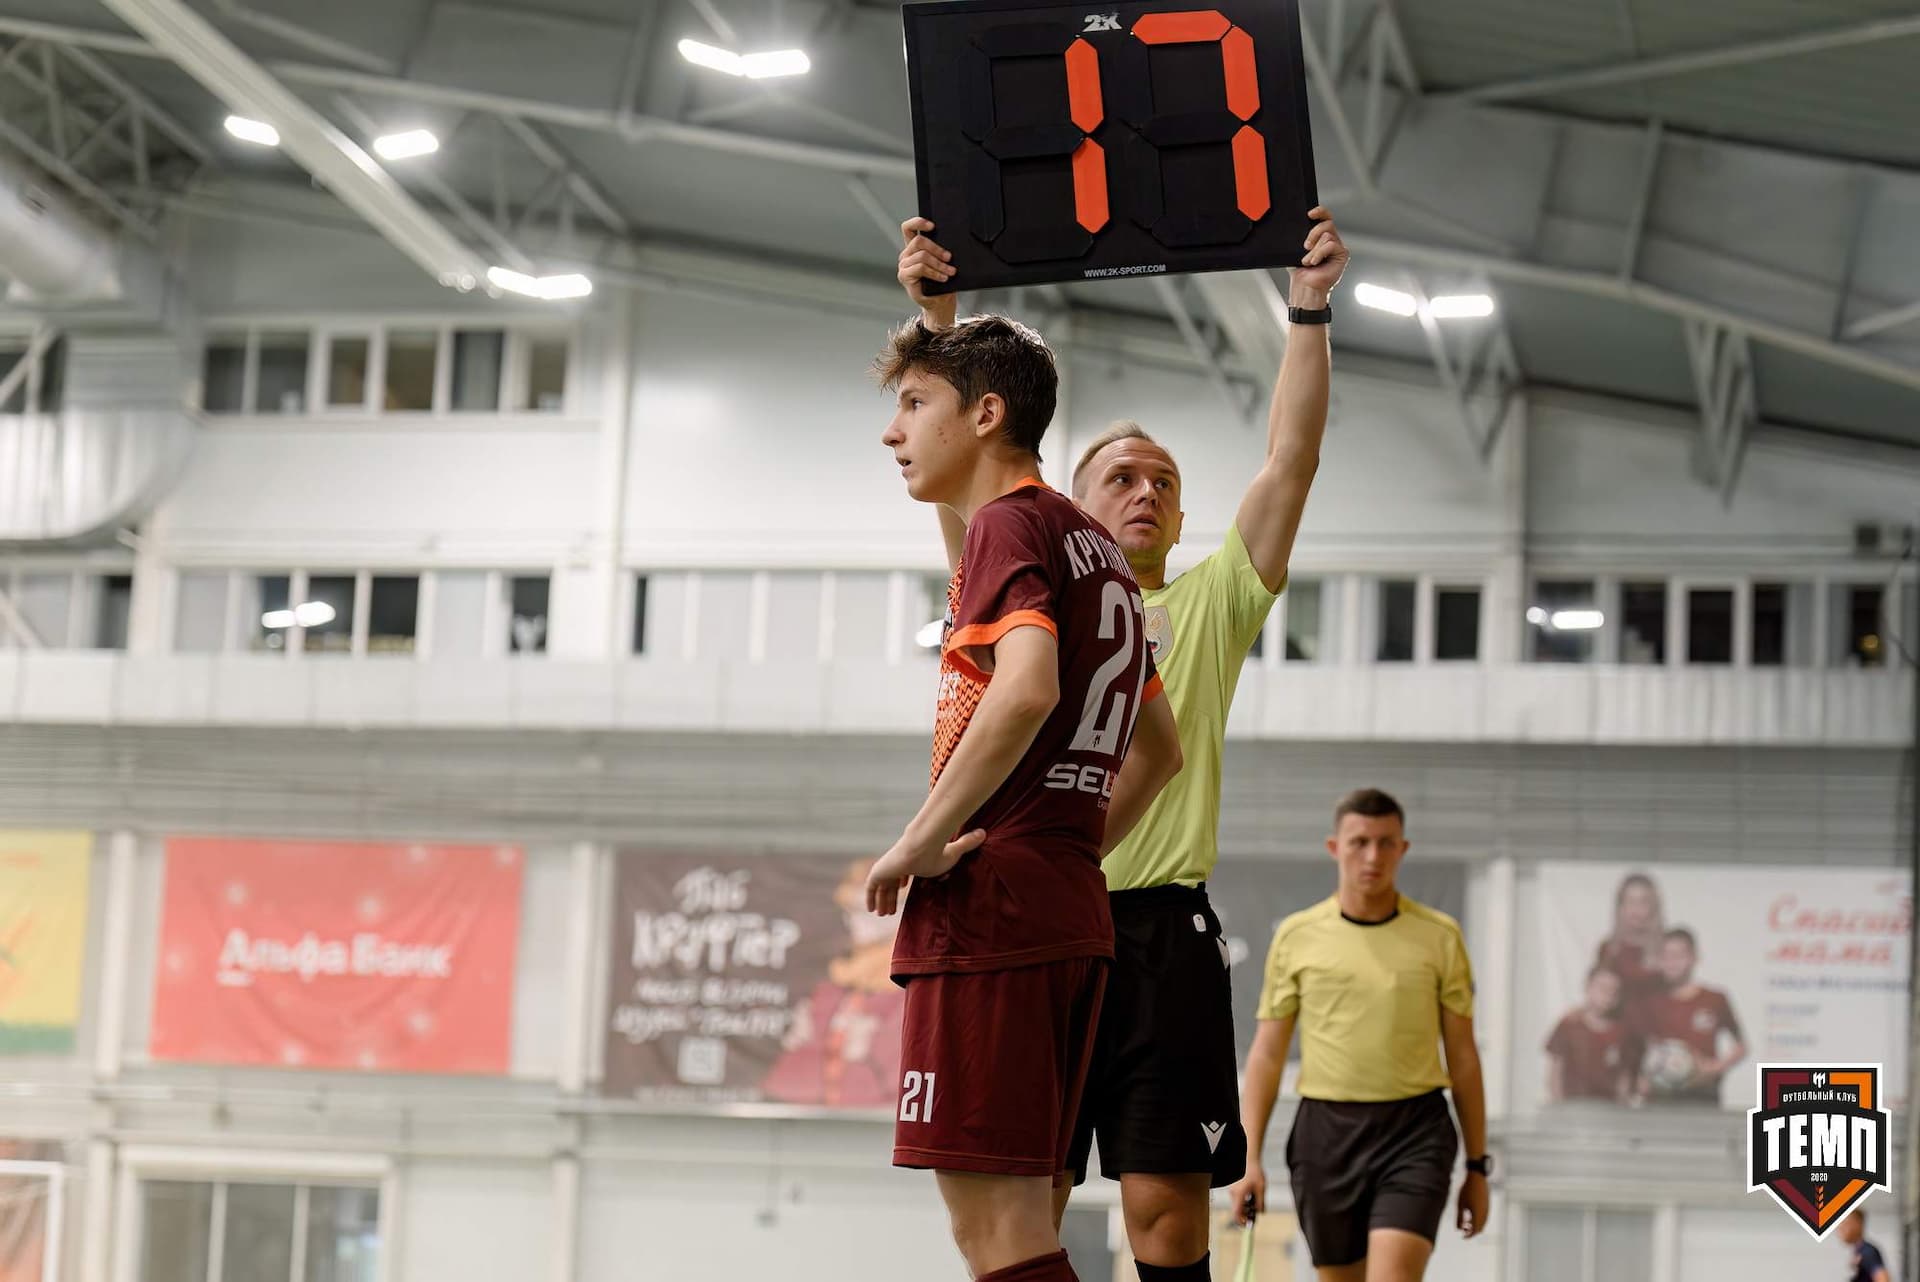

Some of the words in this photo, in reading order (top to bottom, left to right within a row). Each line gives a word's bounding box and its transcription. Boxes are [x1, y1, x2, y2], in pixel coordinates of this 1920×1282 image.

[1083, 12, 1122, 32] 2K
[1065, 10, 1271, 234] 17
[1084, 263, 1166, 278] WWW.2K-SPORT.COM
[217, 929, 347, 985] Альфа
[352, 932, 451, 978] Банк
[900, 1069, 936, 1123] 21
